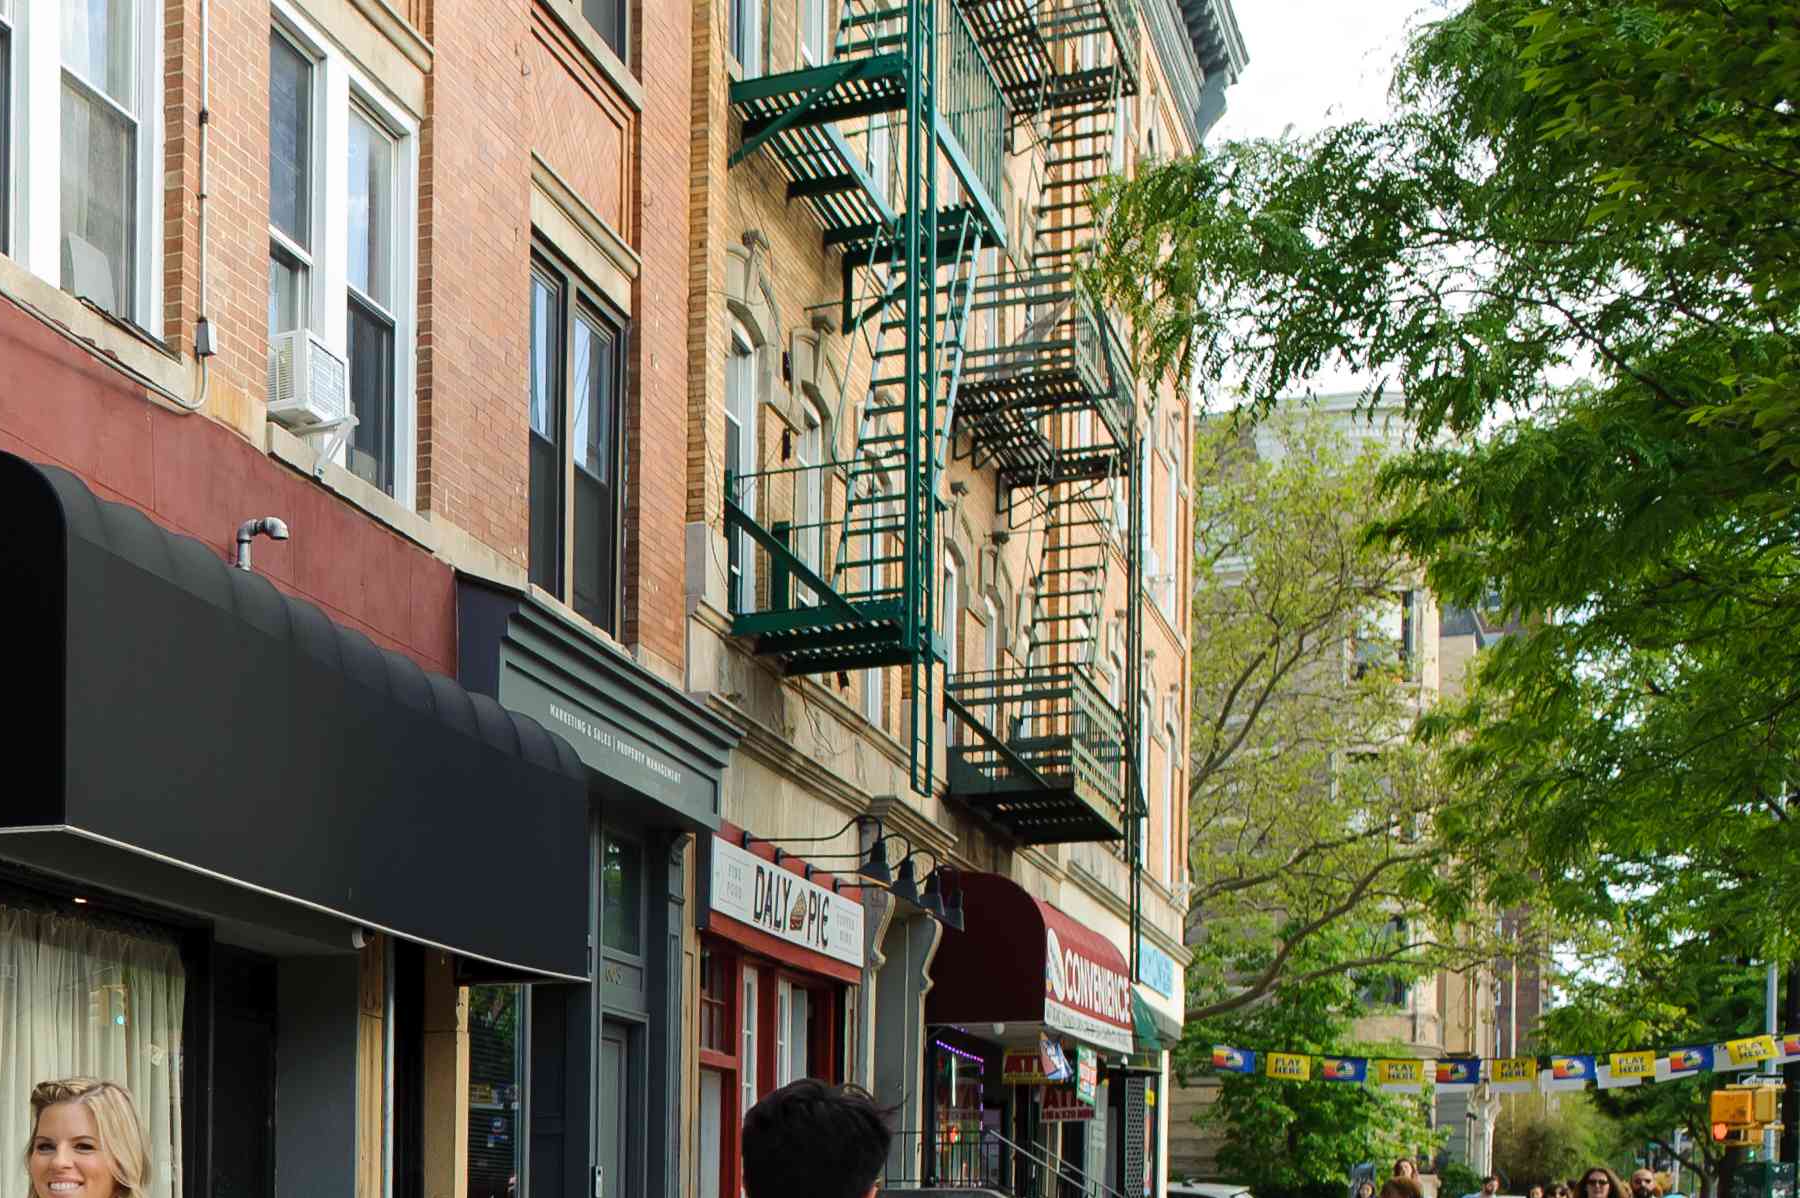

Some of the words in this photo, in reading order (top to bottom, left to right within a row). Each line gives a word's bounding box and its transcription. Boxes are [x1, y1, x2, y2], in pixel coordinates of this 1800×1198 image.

[550, 703, 586, 734] MARKETING
[586, 724, 592, 737] &
[593, 727, 612, 748] SALES
[616, 739, 645, 765] PROPERTY
[646, 755, 681, 784] MANAGEMENT
[752, 864, 792, 933] DALY
[807, 889, 829, 947] PIE
[1064, 948, 1130, 1024] CONVENIENCE
[1275, 1055, 1303, 1066] PLAY
[1387, 1064, 1415, 1072] PLAY
